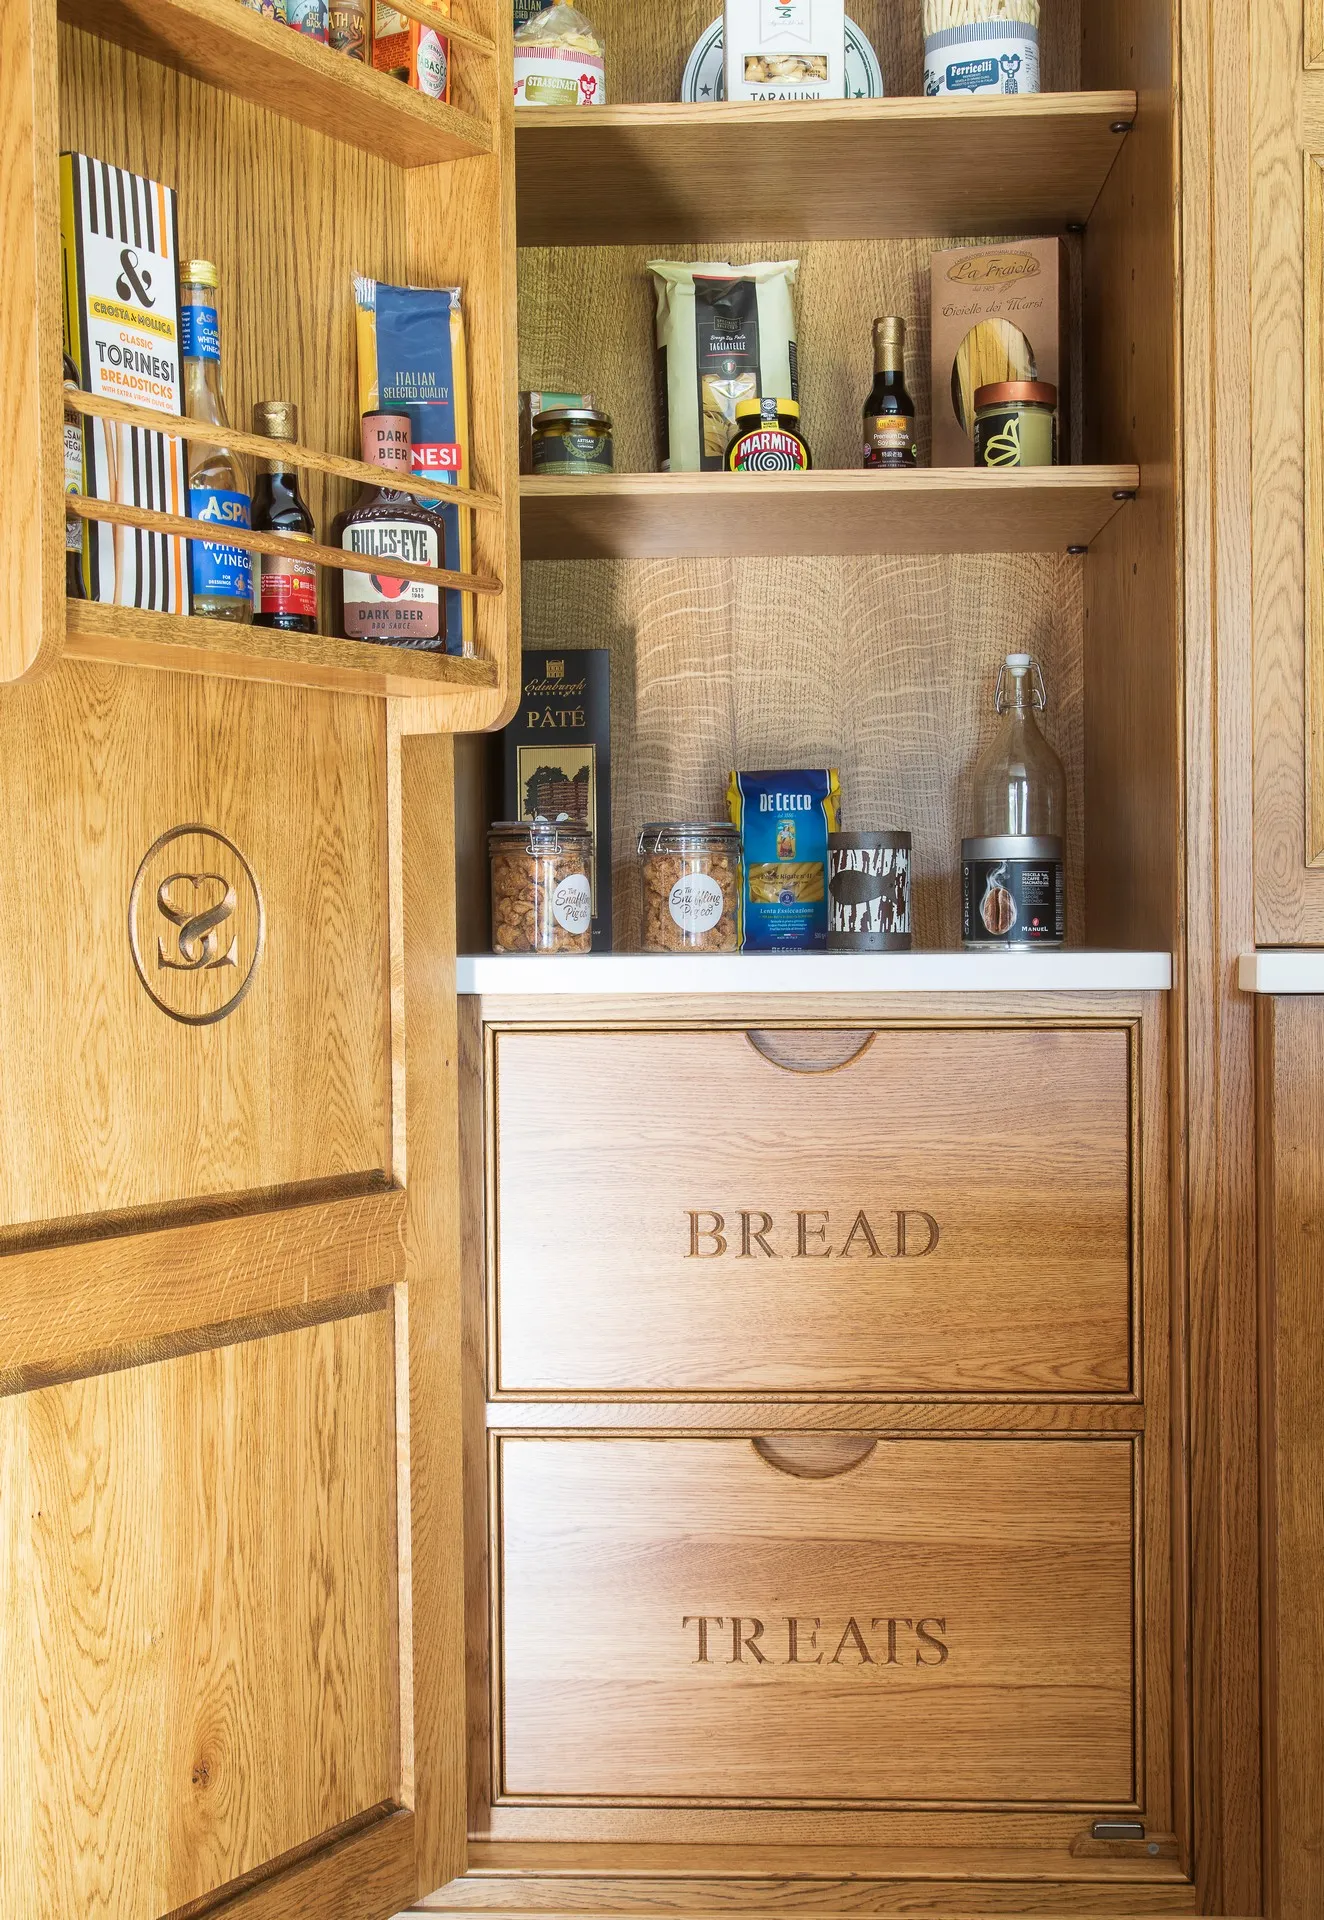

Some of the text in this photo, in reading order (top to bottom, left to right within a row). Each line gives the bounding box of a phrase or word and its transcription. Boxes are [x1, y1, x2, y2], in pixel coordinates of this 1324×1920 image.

[306, 20, 321, 29] BACK
[308, 12, 319, 20] OUT
[951, 60, 992, 77] Ferricelli
[527, 76, 577, 91] STRASCINATI
[115, 249, 156, 308] &
[950, 258, 1037, 281] La Fraiola
[942, 296, 1044, 317] Gioiello dei Marsi
[93, 301, 131, 321] CROSTA
[137, 314, 172, 335] MOLLICA
[119, 332, 153, 351] CLASSIC
[709, 341, 746, 351] TAGLIATELLE
[95, 340, 176, 383] TORINESI
[100, 367, 173, 400] BREADSTICKS
[395, 371, 435, 386] ITALIAN
[101, 384, 116, 394] WITH
[116, 388, 132, 398] EXTRA
[134, 392, 151, 403] VIRGIN
[151, 398, 165, 408] OLIVE
[383, 387, 449, 399] SELECTED QUALITY
[377, 430, 408, 443] DARK
[740, 433, 798, 458] MARMITE
[378, 447, 408, 461] BEER
[411, 448, 457, 465] NESI
[293, 564, 306, 574] Soy
[358, 609, 424, 620] DARK BEER
[524, 677, 587, 697] Edinburgh
[526, 704, 586, 728] PÂTÉ
[759, 792, 812, 812] DE CECCO
[683, 1209, 940, 1259] BREAD
[682, 1616, 949, 1666] TREATS
